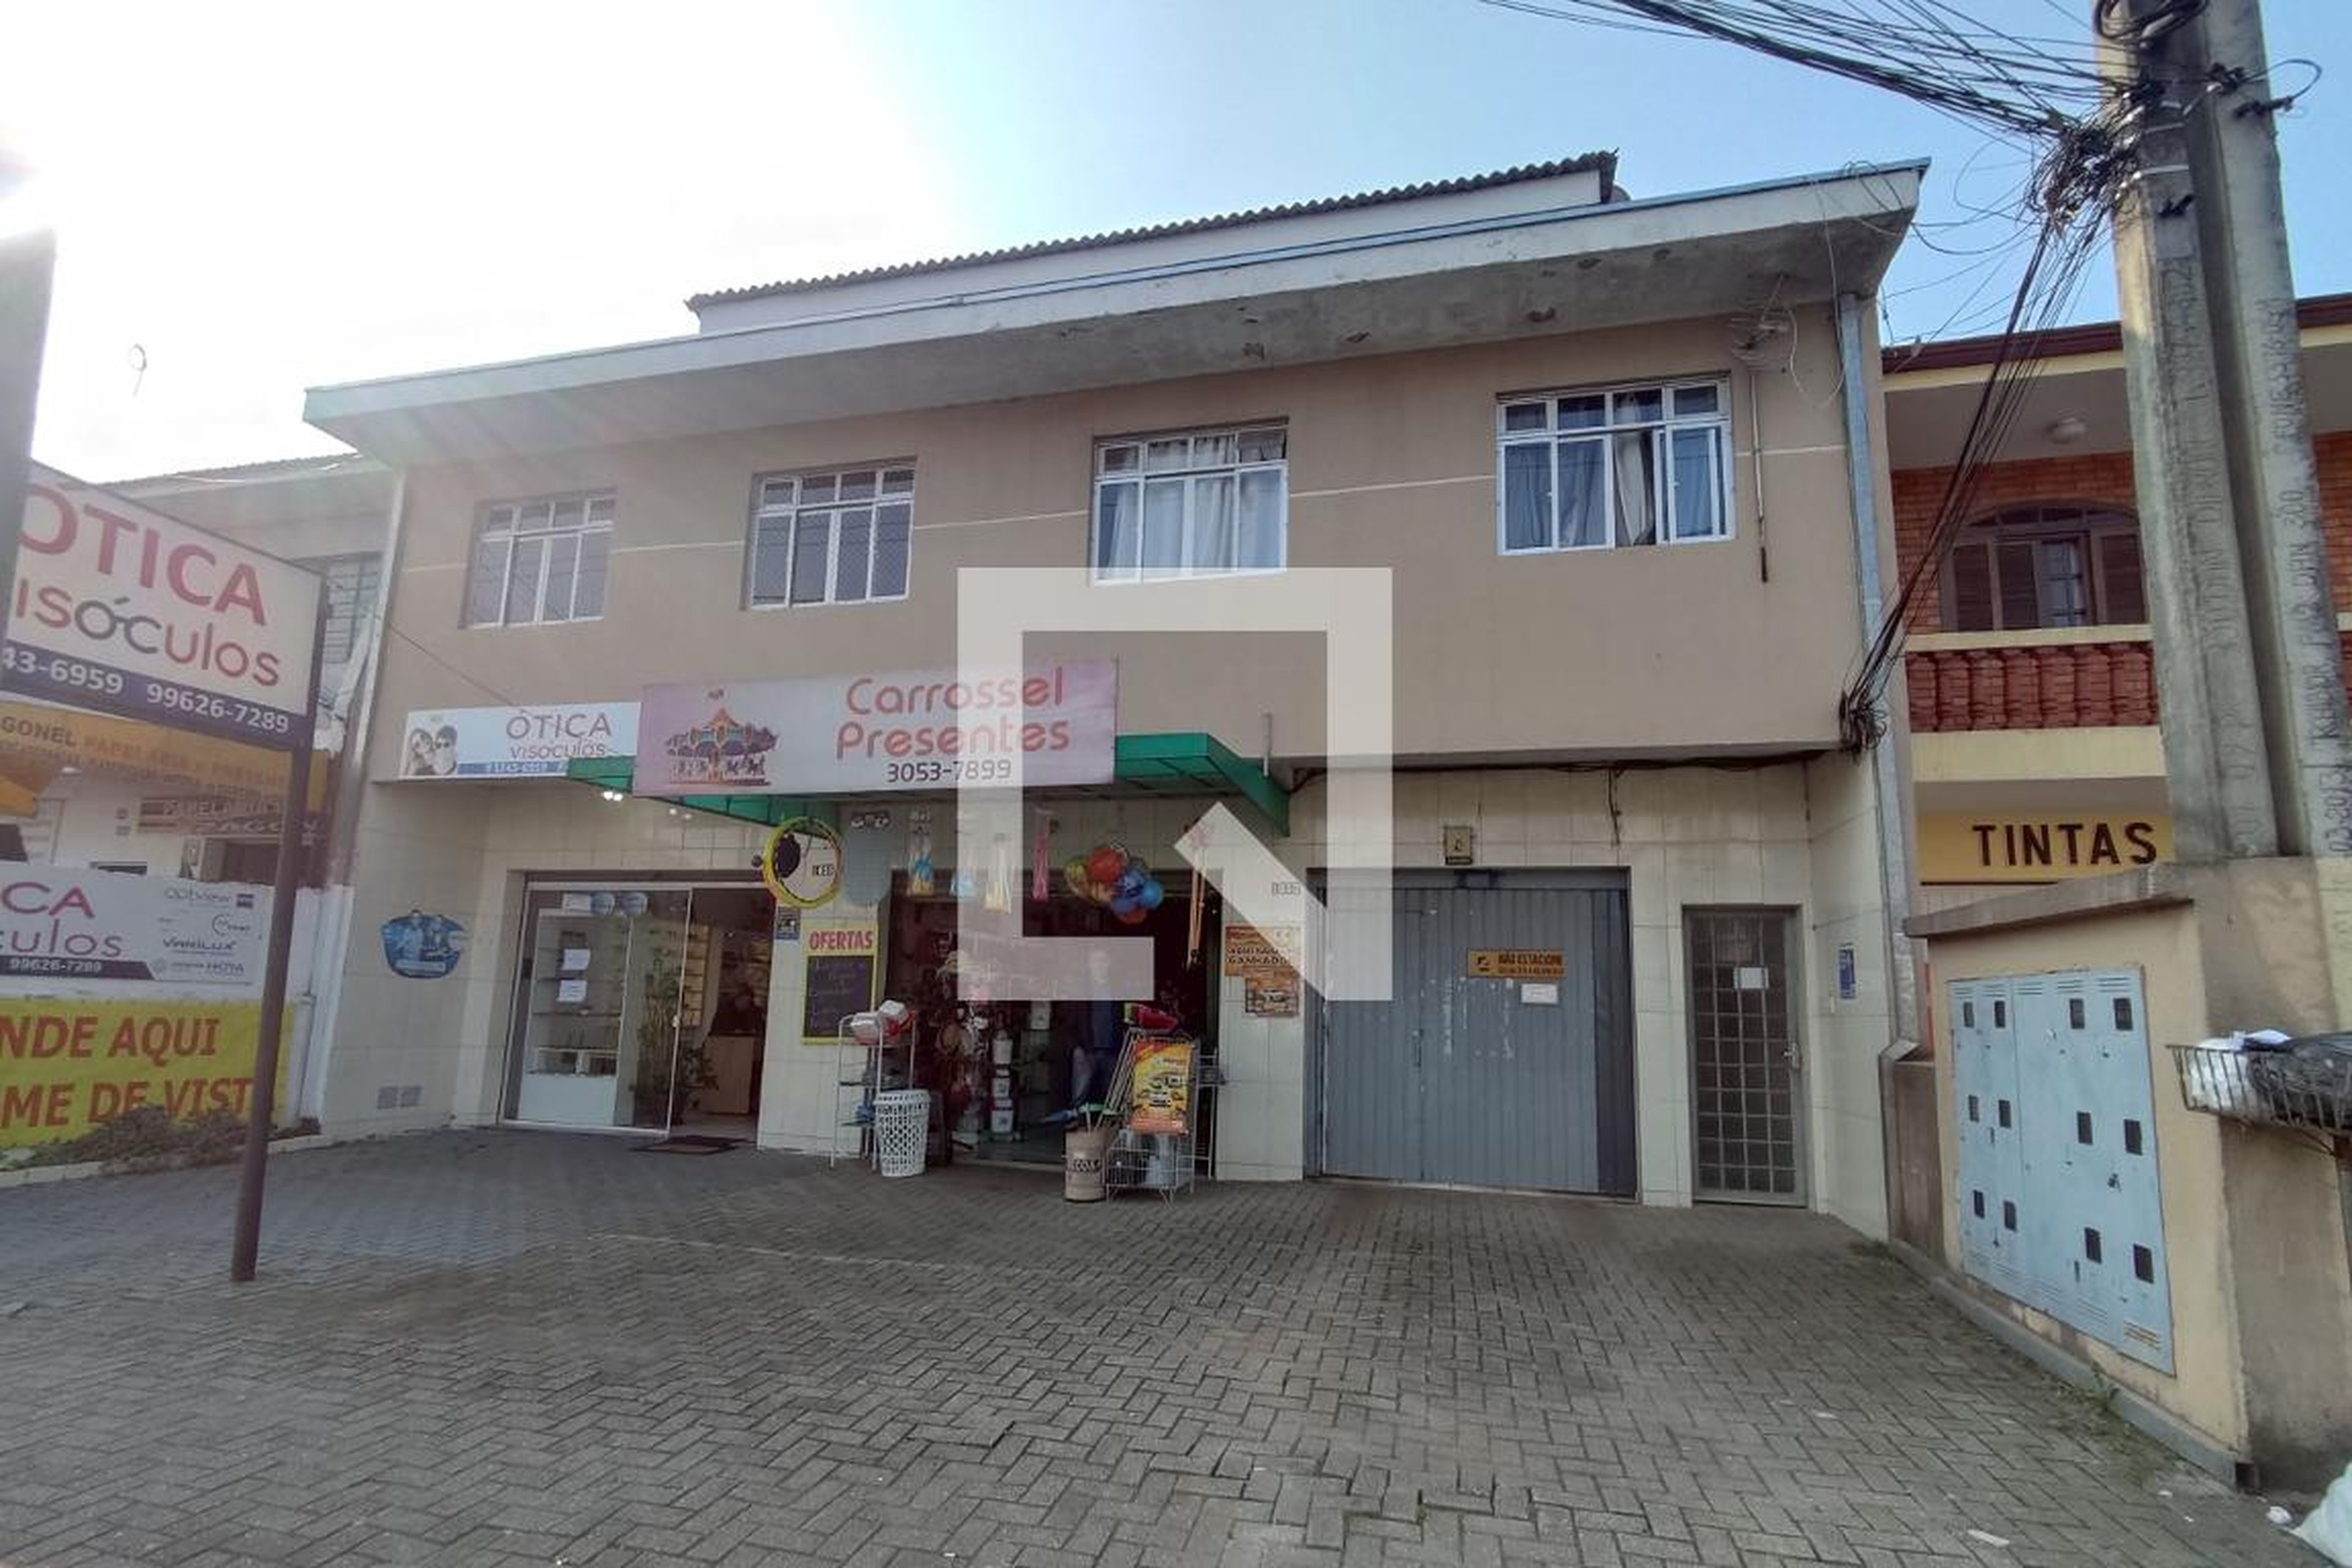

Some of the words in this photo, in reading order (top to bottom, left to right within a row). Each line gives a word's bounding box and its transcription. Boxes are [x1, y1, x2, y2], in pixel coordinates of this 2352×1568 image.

[146, 683, 289, 733] 99626-7289
[846, 666, 1063, 715] Carrossel
[836, 716, 1070, 760] Presentes
[888, 760, 1012, 782] 3053-7899
[1972, 822, 2158, 866] TINTAS
[1, 882, 95, 918] CA
[0, 918, 123, 957] ulos
[809, 930, 873, 950] OFERTAS
[0, 1016, 98, 1058] NDE
[107, 1016, 221, 1066] AQUI
